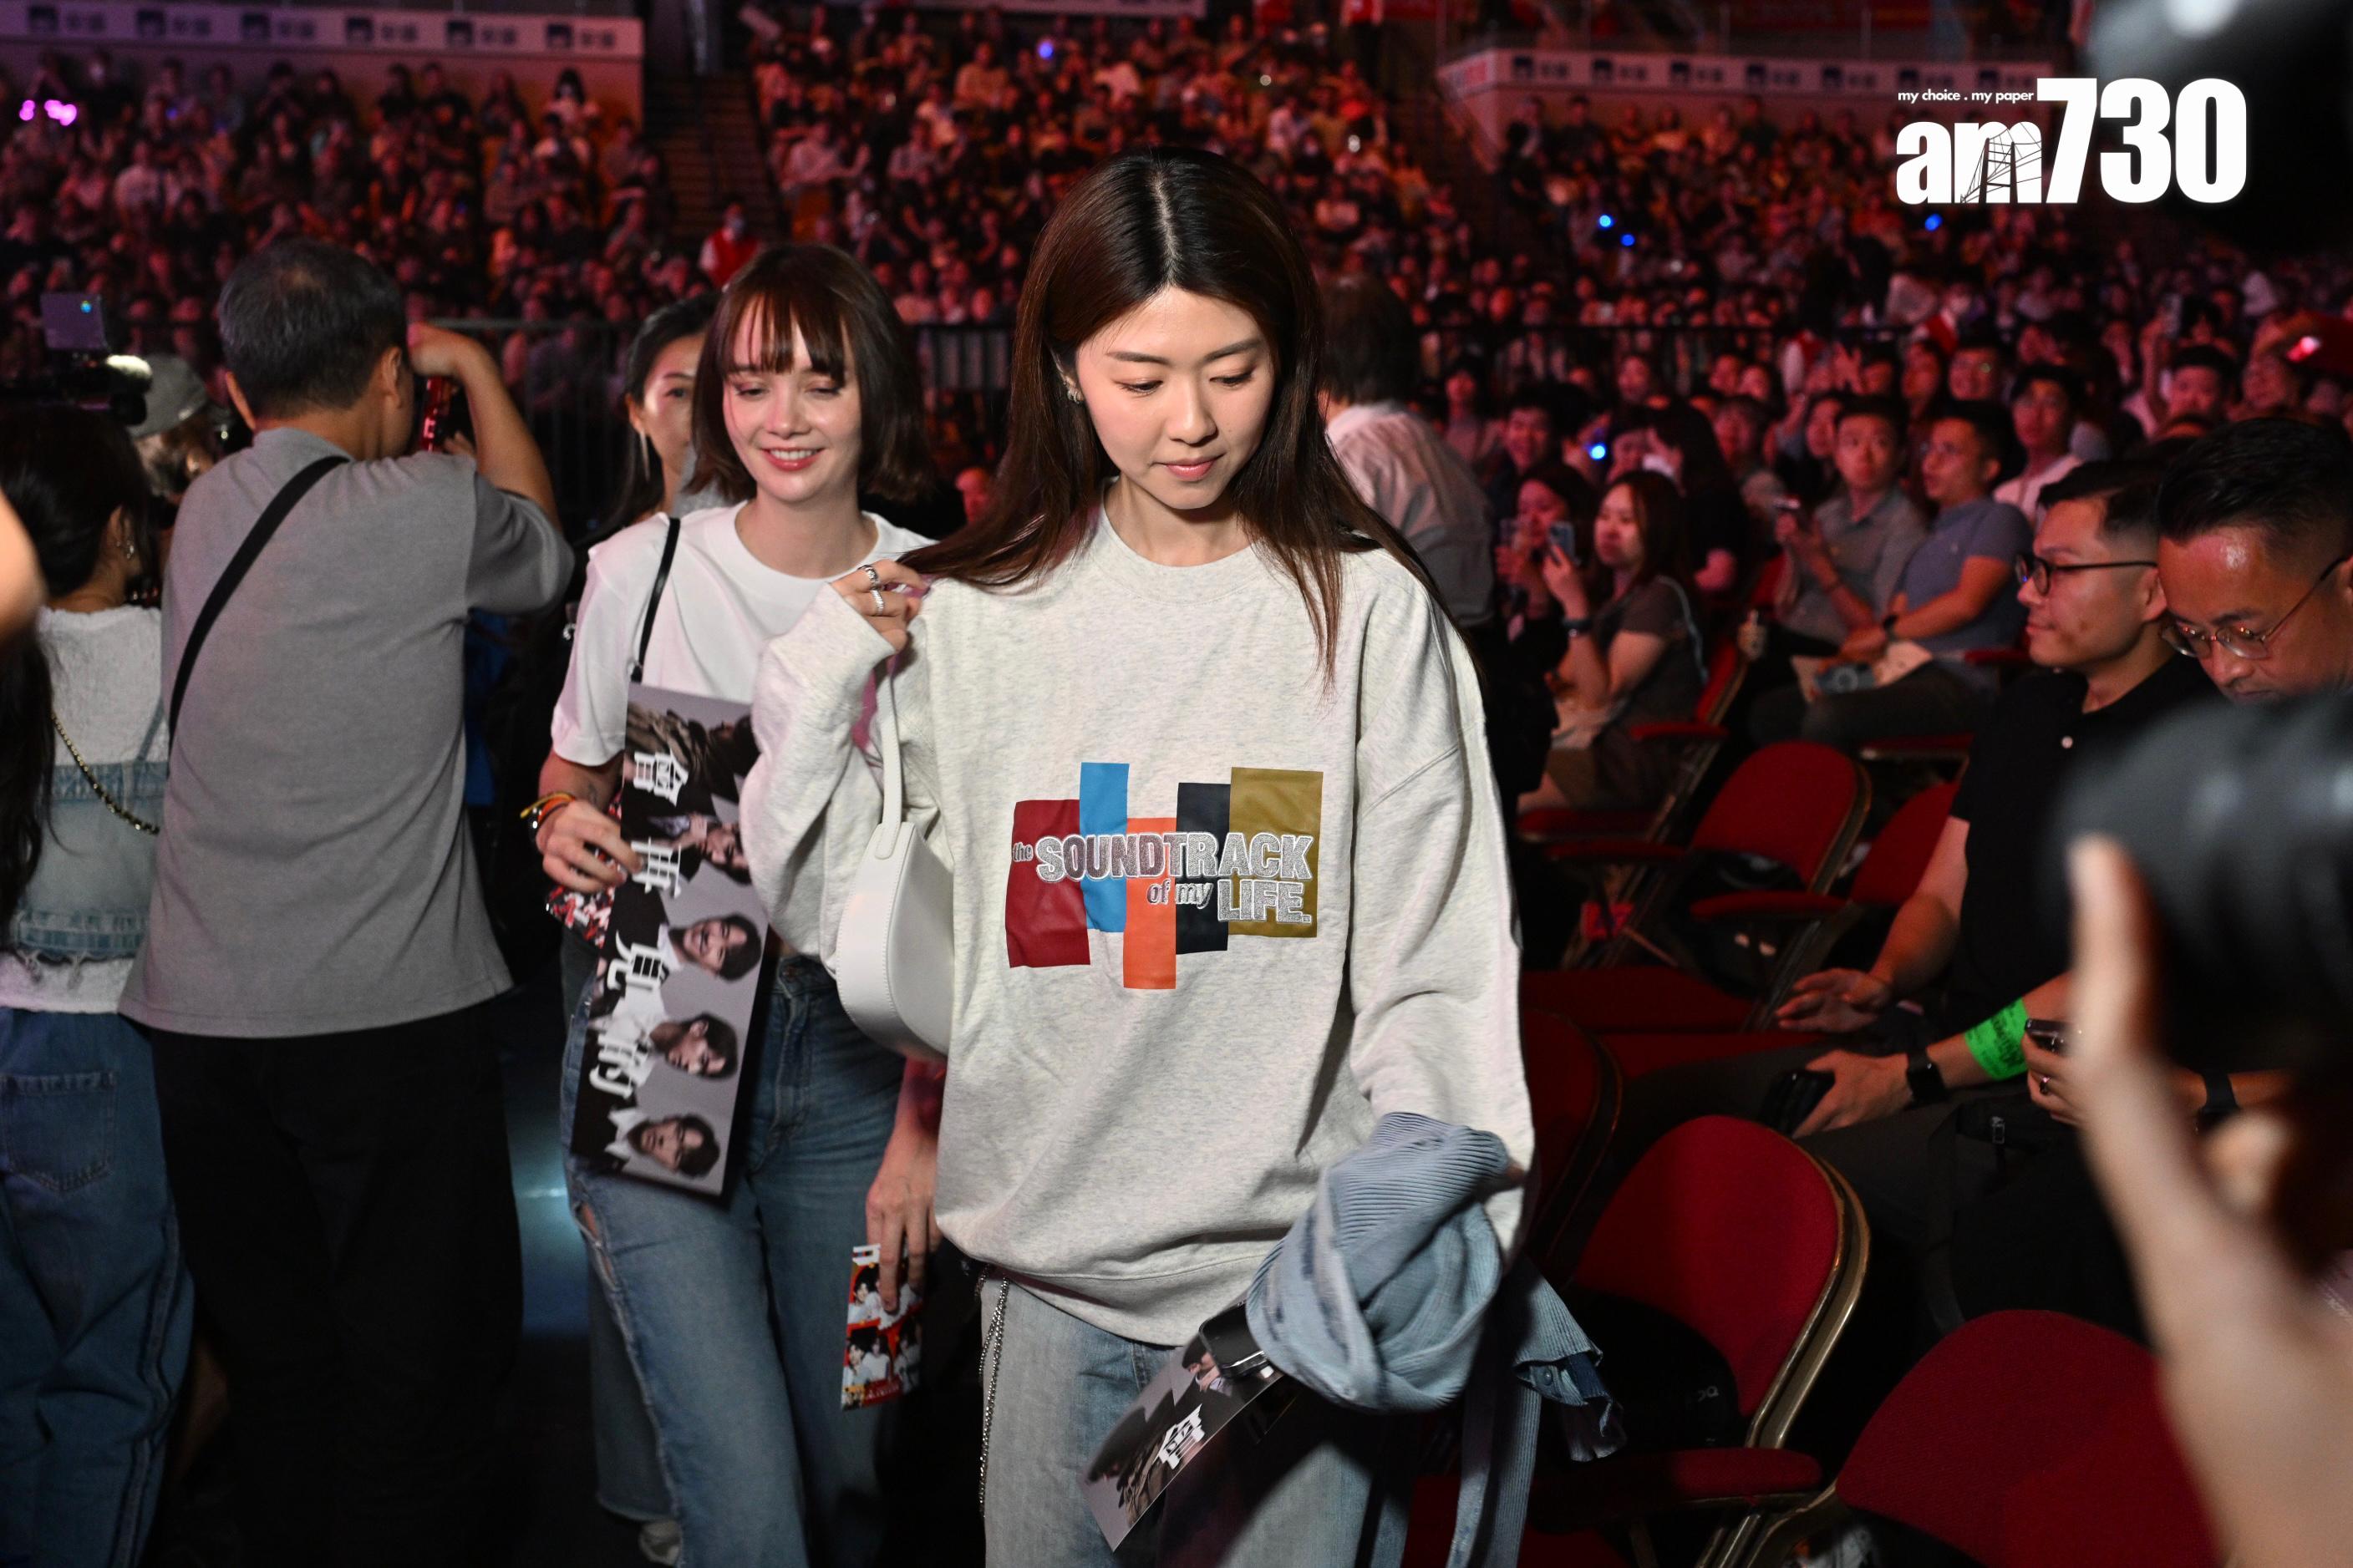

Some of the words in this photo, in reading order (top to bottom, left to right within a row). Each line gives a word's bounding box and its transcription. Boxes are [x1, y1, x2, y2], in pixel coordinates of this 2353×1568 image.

[1012, 842, 1034, 862] the
[1035, 832, 1314, 882] SOUNDTRACK
[1146, 879, 1171, 905] of
[1174, 881, 1214, 910] my
